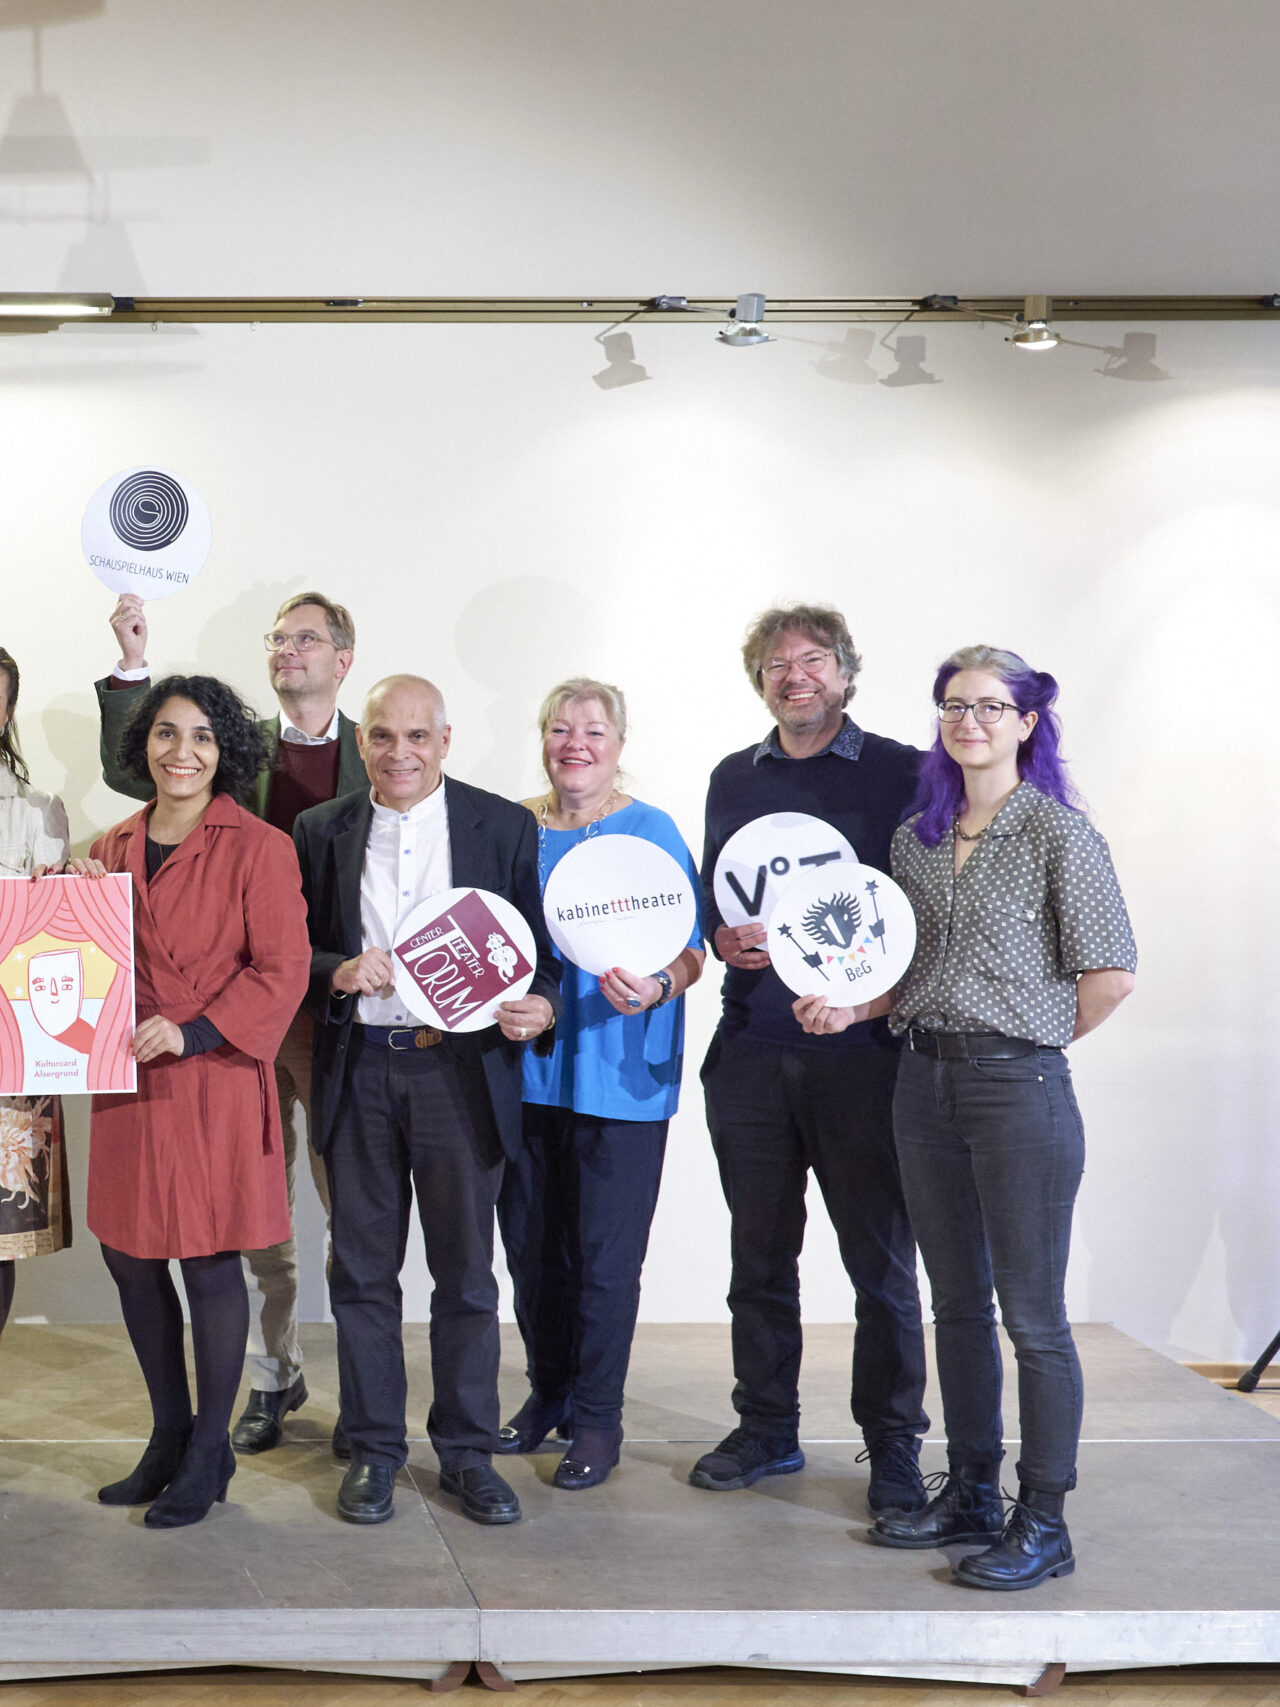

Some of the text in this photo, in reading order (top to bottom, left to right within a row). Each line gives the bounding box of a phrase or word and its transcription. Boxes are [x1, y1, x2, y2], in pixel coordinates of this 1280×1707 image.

[89, 554, 190, 584] SCHAUSPIELHAUS WIEN
[557, 893, 683, 921] kabinetttheater
[410, 926, 444, 948] CENTER
[33, 1069, 79, 1078] Alsergrund
[35, 1058, 77, 1068] Kulturcard
